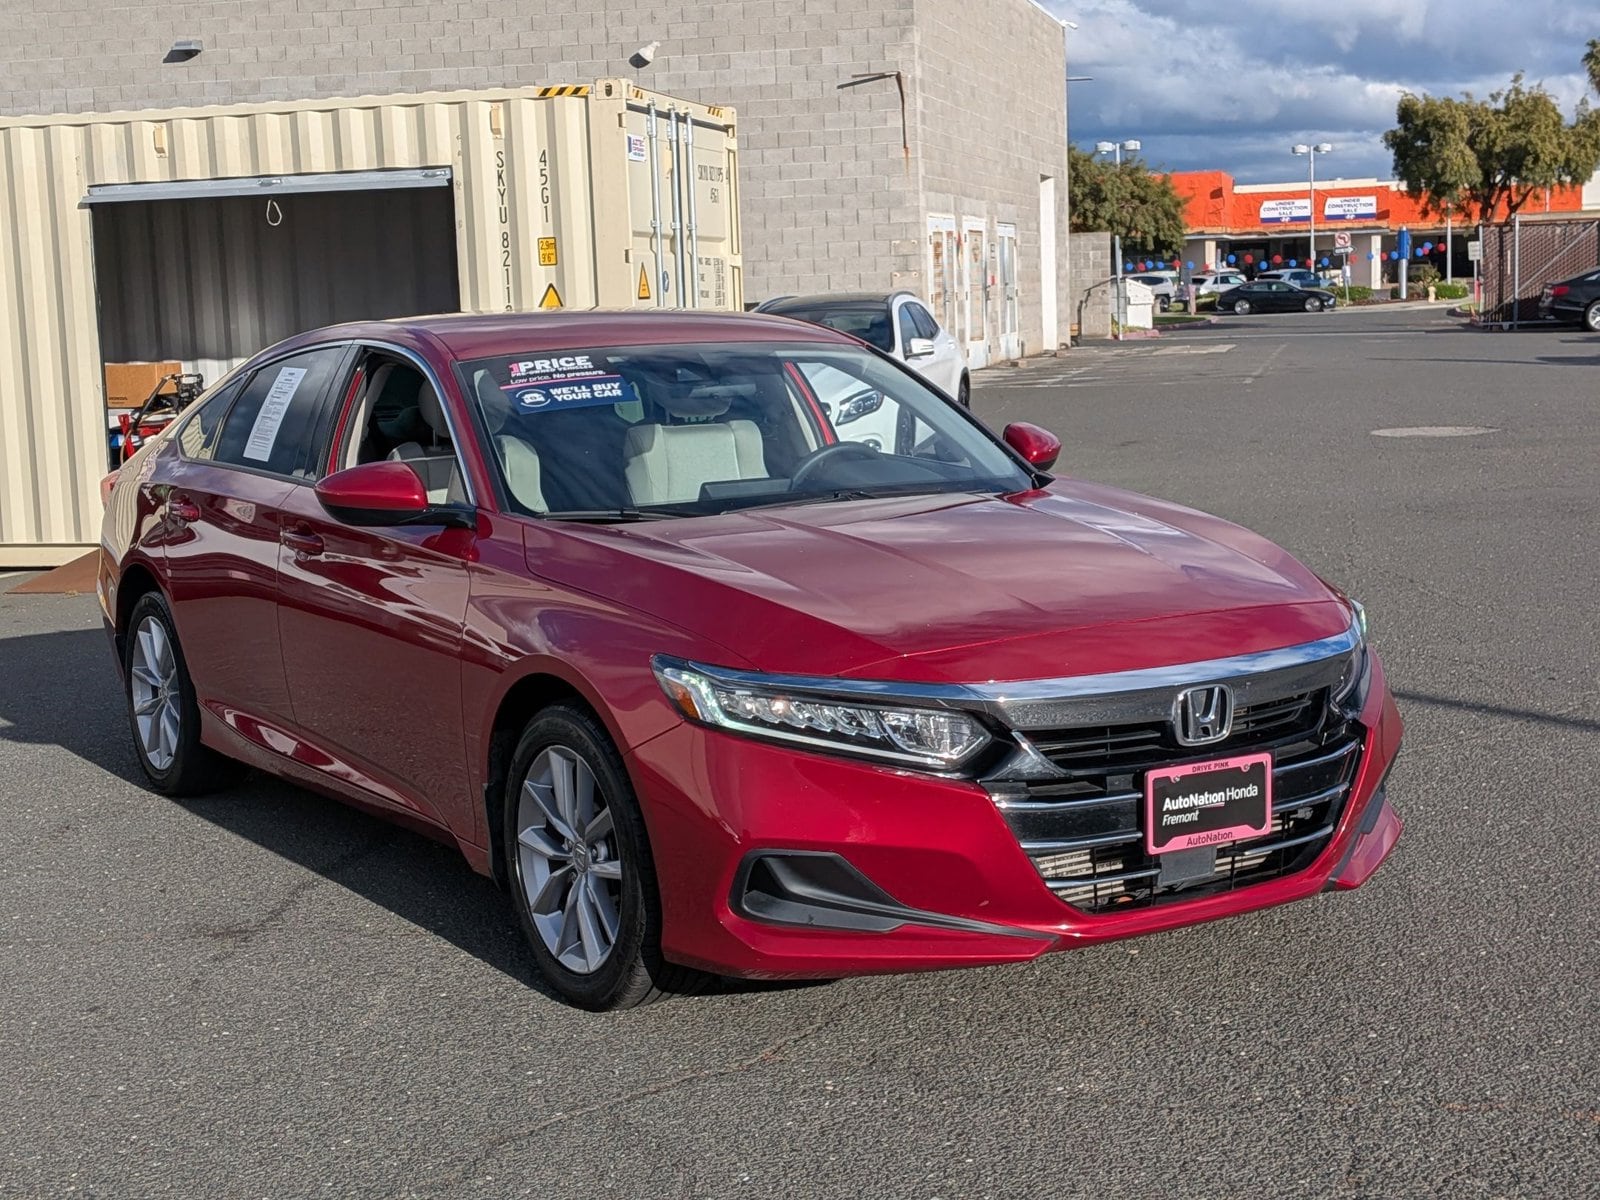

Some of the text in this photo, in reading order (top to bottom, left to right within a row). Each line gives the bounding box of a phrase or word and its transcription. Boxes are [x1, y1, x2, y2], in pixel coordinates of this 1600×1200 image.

[496, 150, 508, 224] SKYU
[539, 149, 550, 223] 45G1
[567, 370, 606, 378] pressure.
[549, 382, 621, 395] WE'LL BUY
[553, 389, 623, 401] YOUR CAR
[1192, 761, 1230, 773] DRIVE PINK
[1162, 783, 1259, 812] AutoNation Honda
[1162, 809, 1200, 827] Fremont
[1186, 830, 1233, 847] AutoNation
